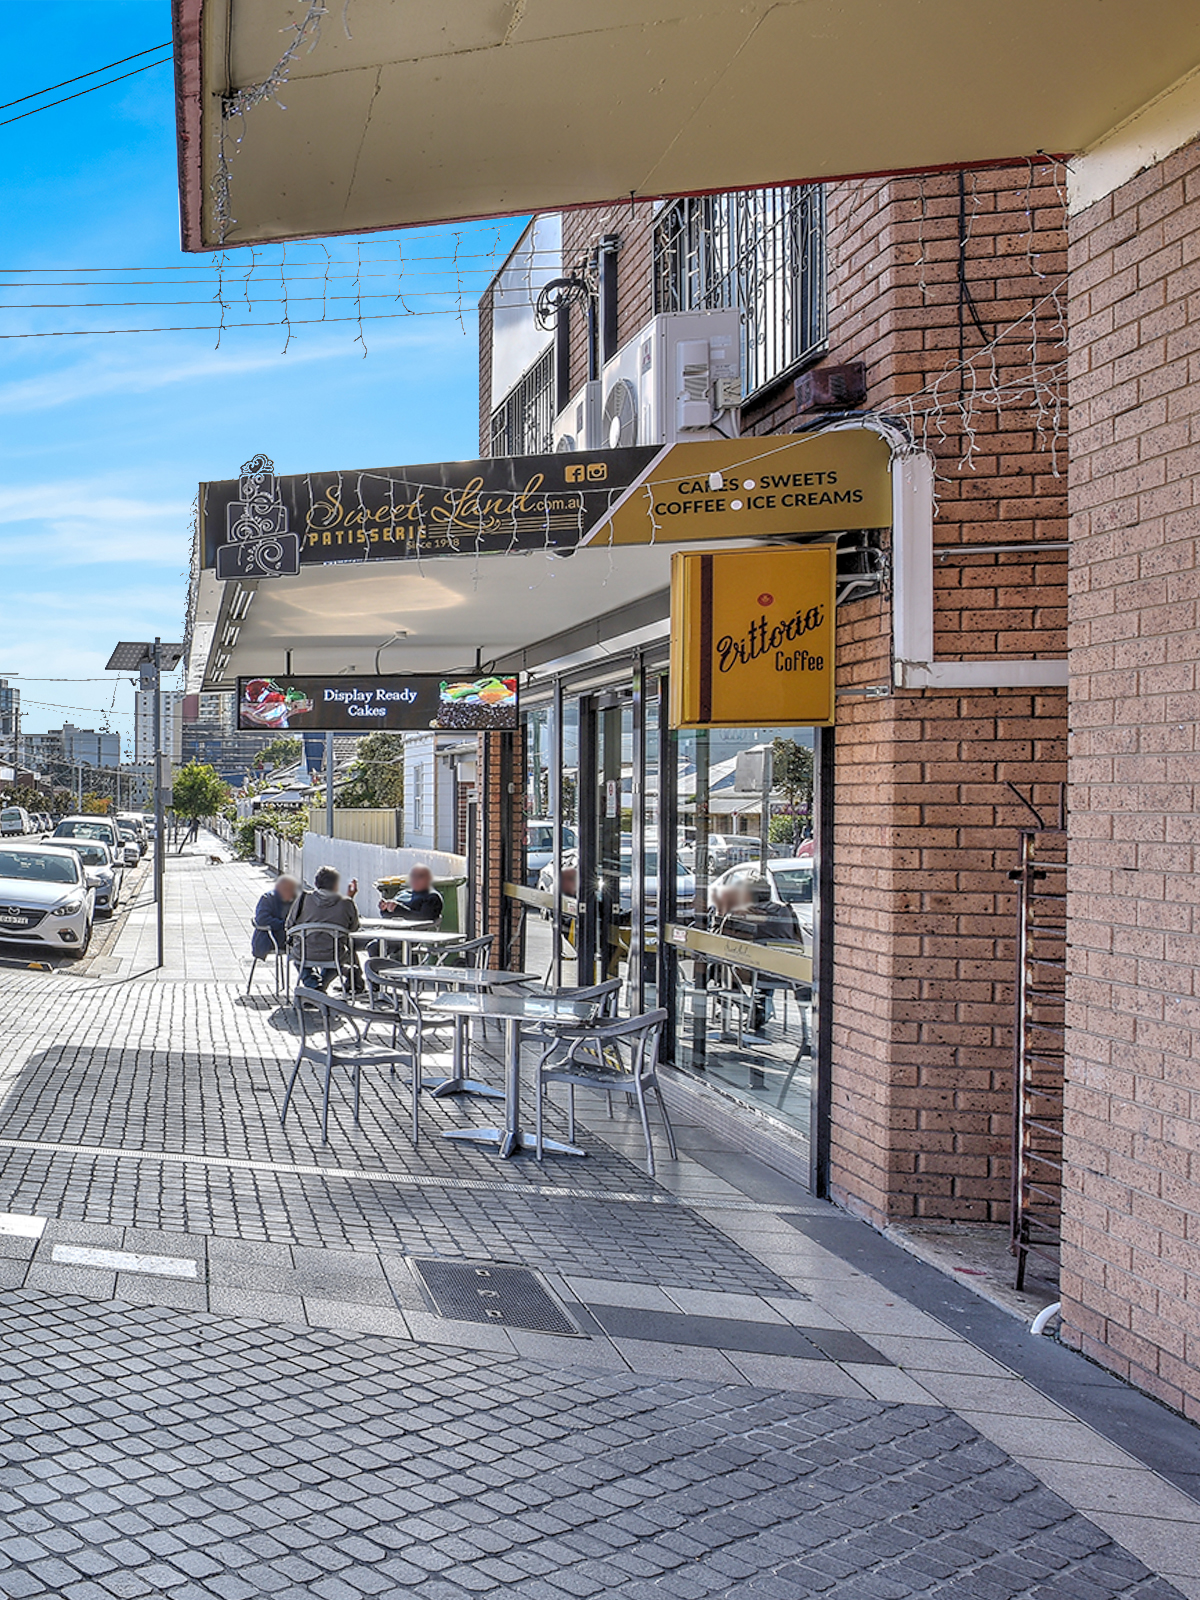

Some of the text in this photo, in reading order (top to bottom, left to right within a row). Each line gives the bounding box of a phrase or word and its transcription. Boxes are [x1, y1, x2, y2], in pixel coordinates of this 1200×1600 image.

[760, 471, 838, 489] SWEETS
[306, 485, 425, 530] Sweet
[655, 489, 864, 516] COFFEE ICE CREAMS
[406, 540, 432, 550] Sice
[716, 605, 825, 673] Vittoria
[775, 650, 824, 672] Coffee
[323, 688, 418, 704] Display Ready
[347, 705, 387, 717] Cakes
